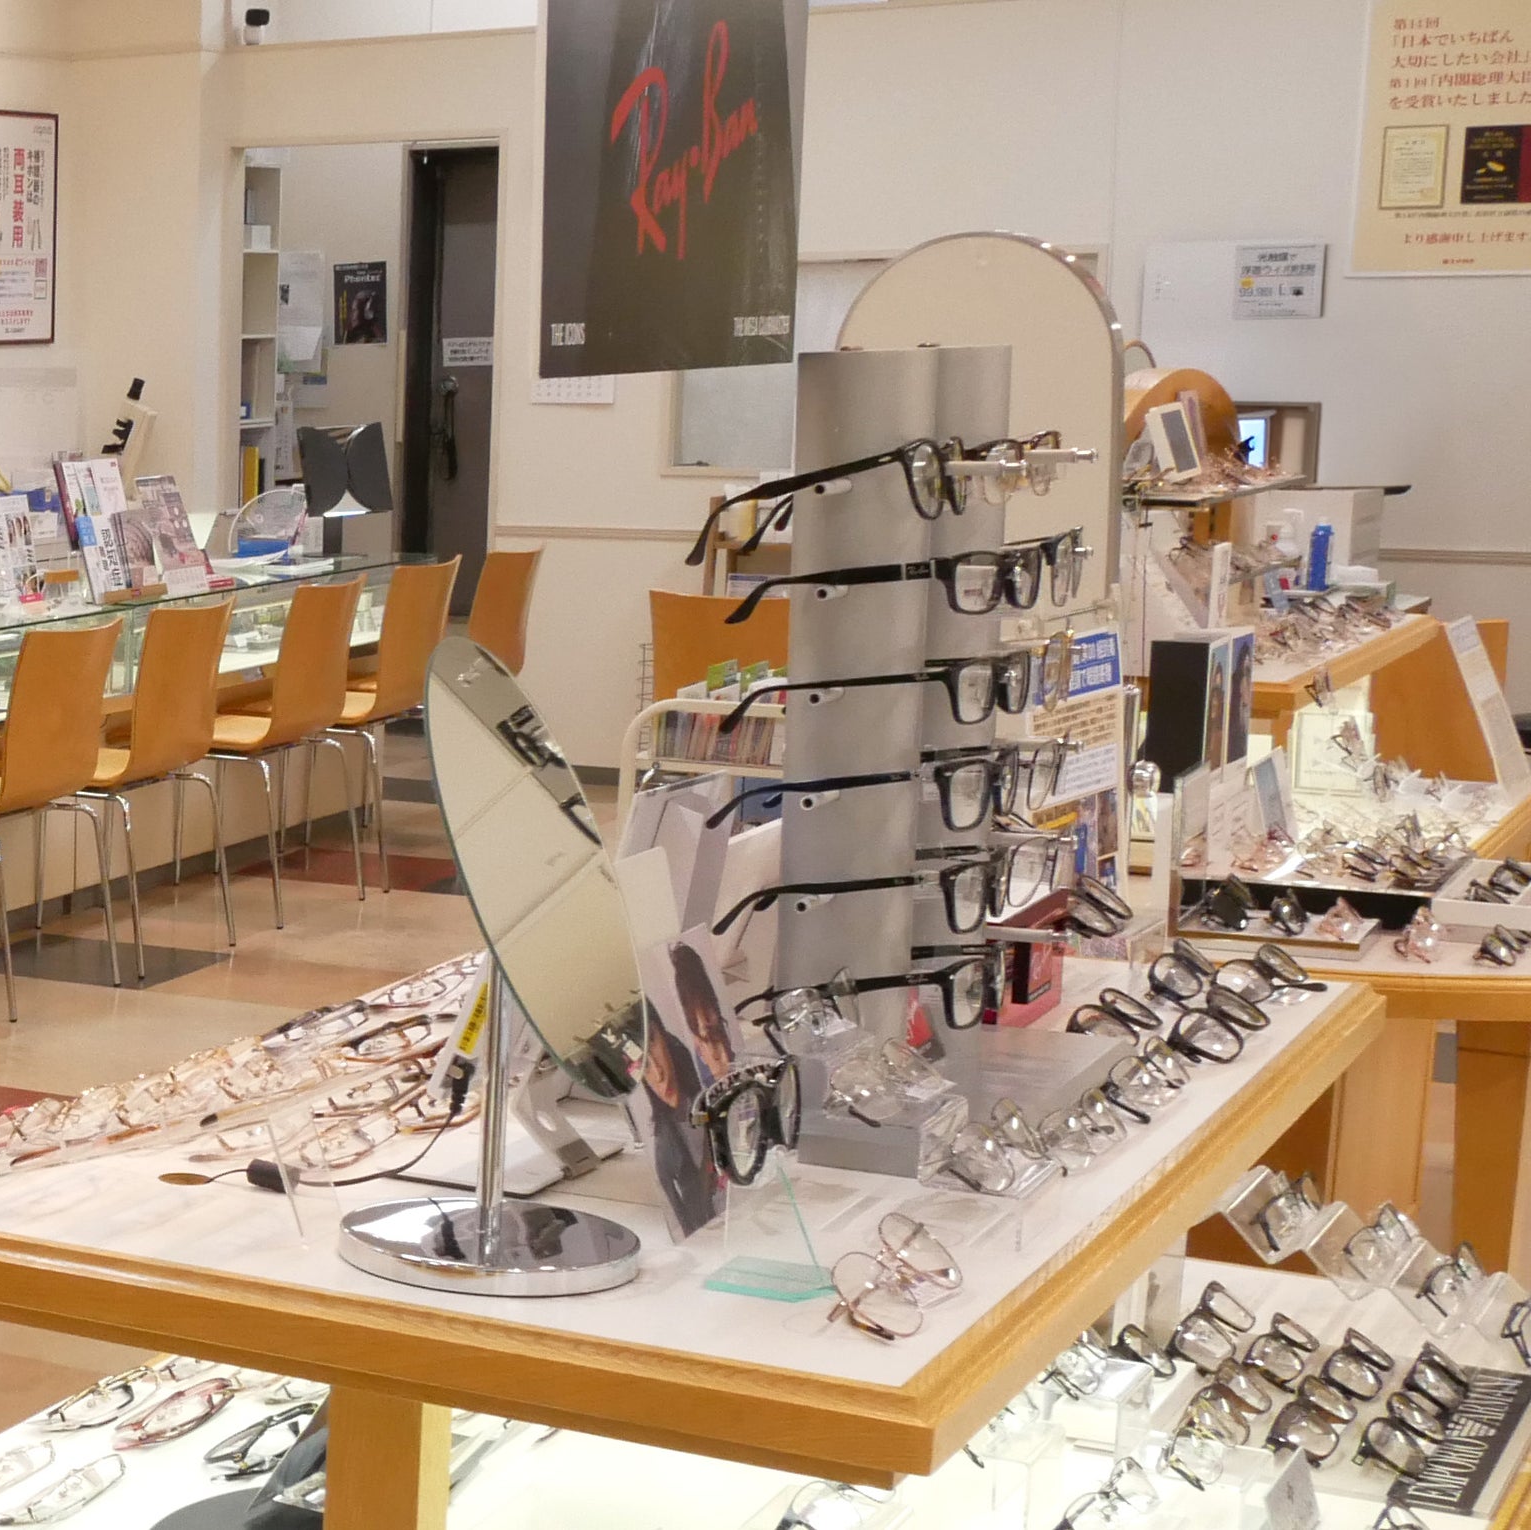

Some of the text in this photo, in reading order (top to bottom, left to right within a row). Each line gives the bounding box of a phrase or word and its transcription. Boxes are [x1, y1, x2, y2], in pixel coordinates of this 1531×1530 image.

[1392, 50, 1529, 68] 大切にしたい会社」
[1393, 30, 1514, 48] 「日本でいちばん
[12, 148, 25, 249] 両耳装用
[1407, 1436, 1488, 1502] EMPORIO
